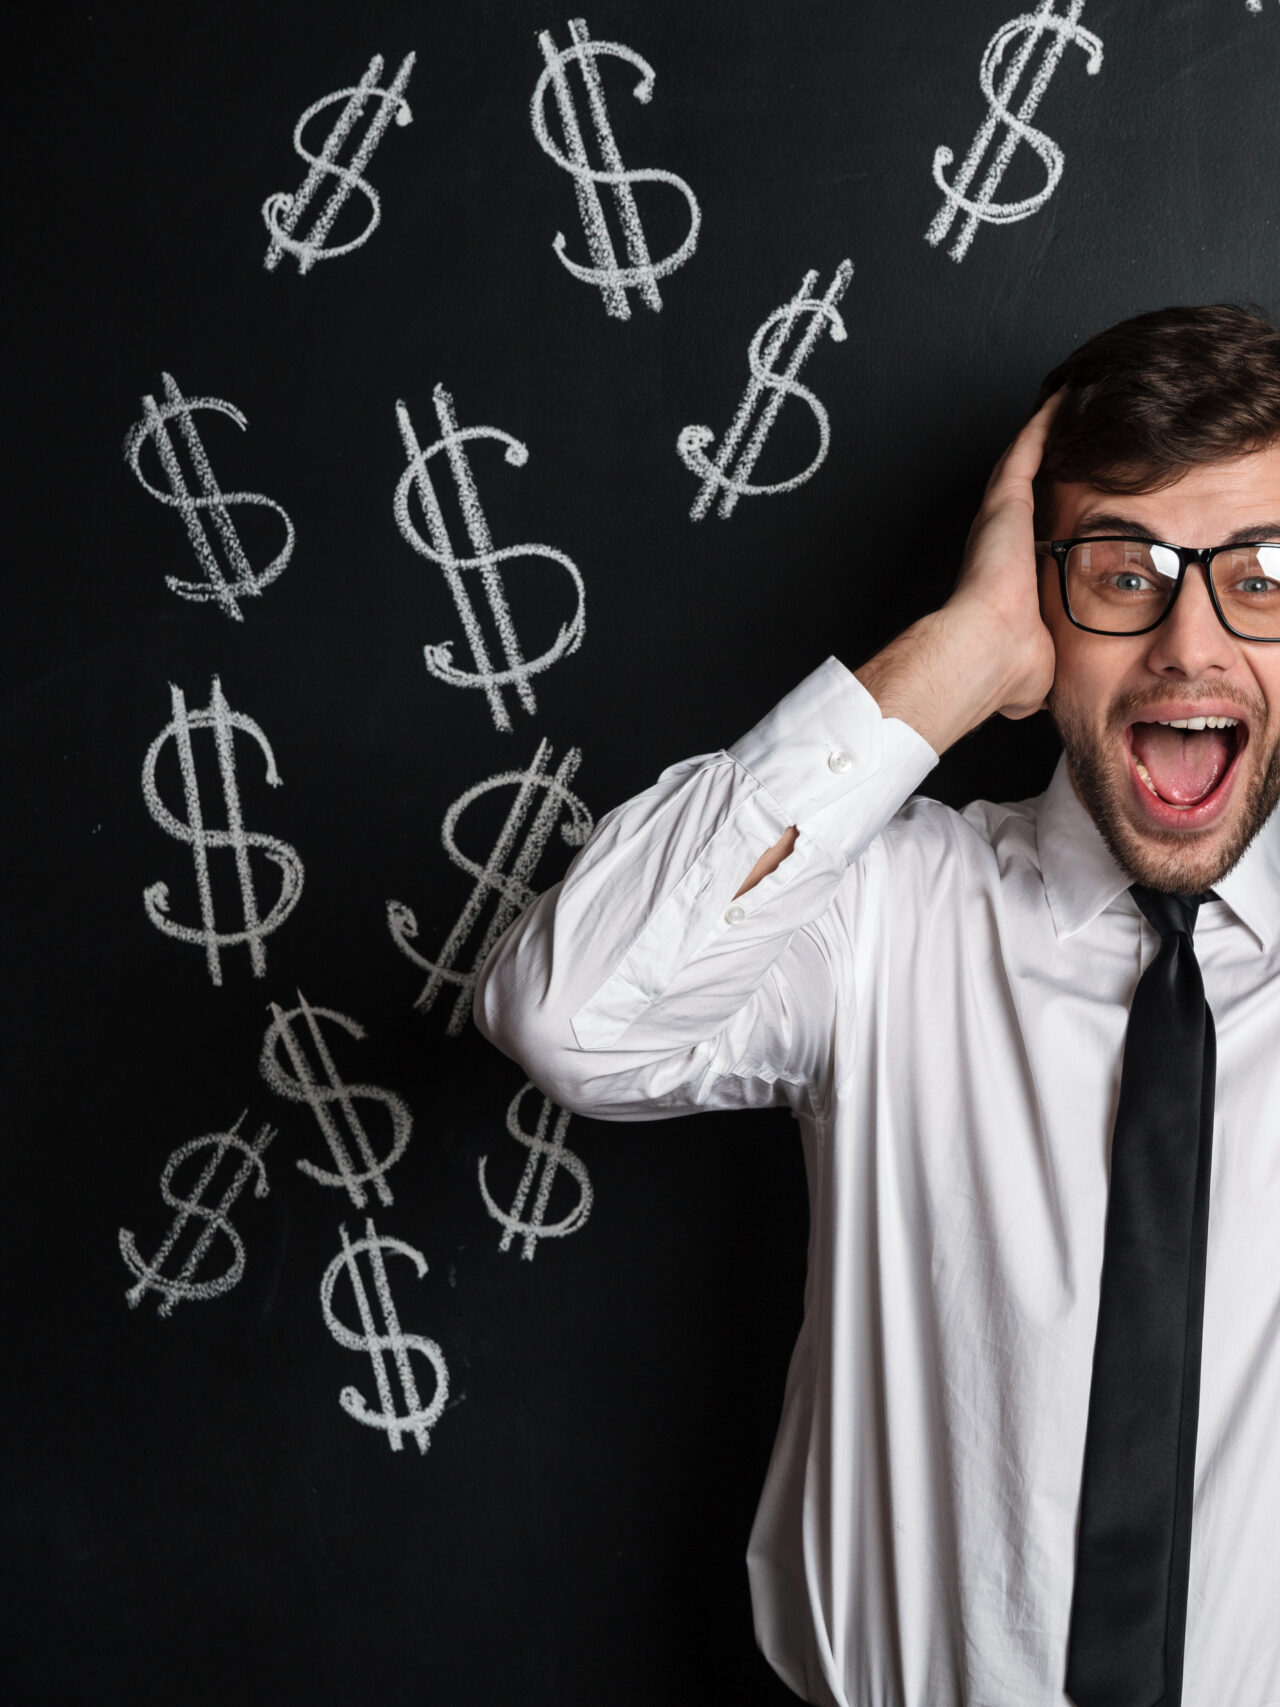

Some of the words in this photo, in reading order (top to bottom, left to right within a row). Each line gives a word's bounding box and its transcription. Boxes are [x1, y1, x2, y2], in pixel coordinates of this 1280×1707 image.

[262, 52, 417, 276] $
[531, 19, 703, 321] $
[925, 0, 1105, 264] $
[126, 373, 296, 623] $
[677, 259, 855, 522] $
[394, 383, 587, 732] $
[142, 675, 305, 987] $
[388, 738, 592, 1036] $
[120, 1109, 277, 1318] $
[262, 989, 413, 1210] $
[479, 1085, 594, 1262] $
[321, 1219, 451, 1456] $
